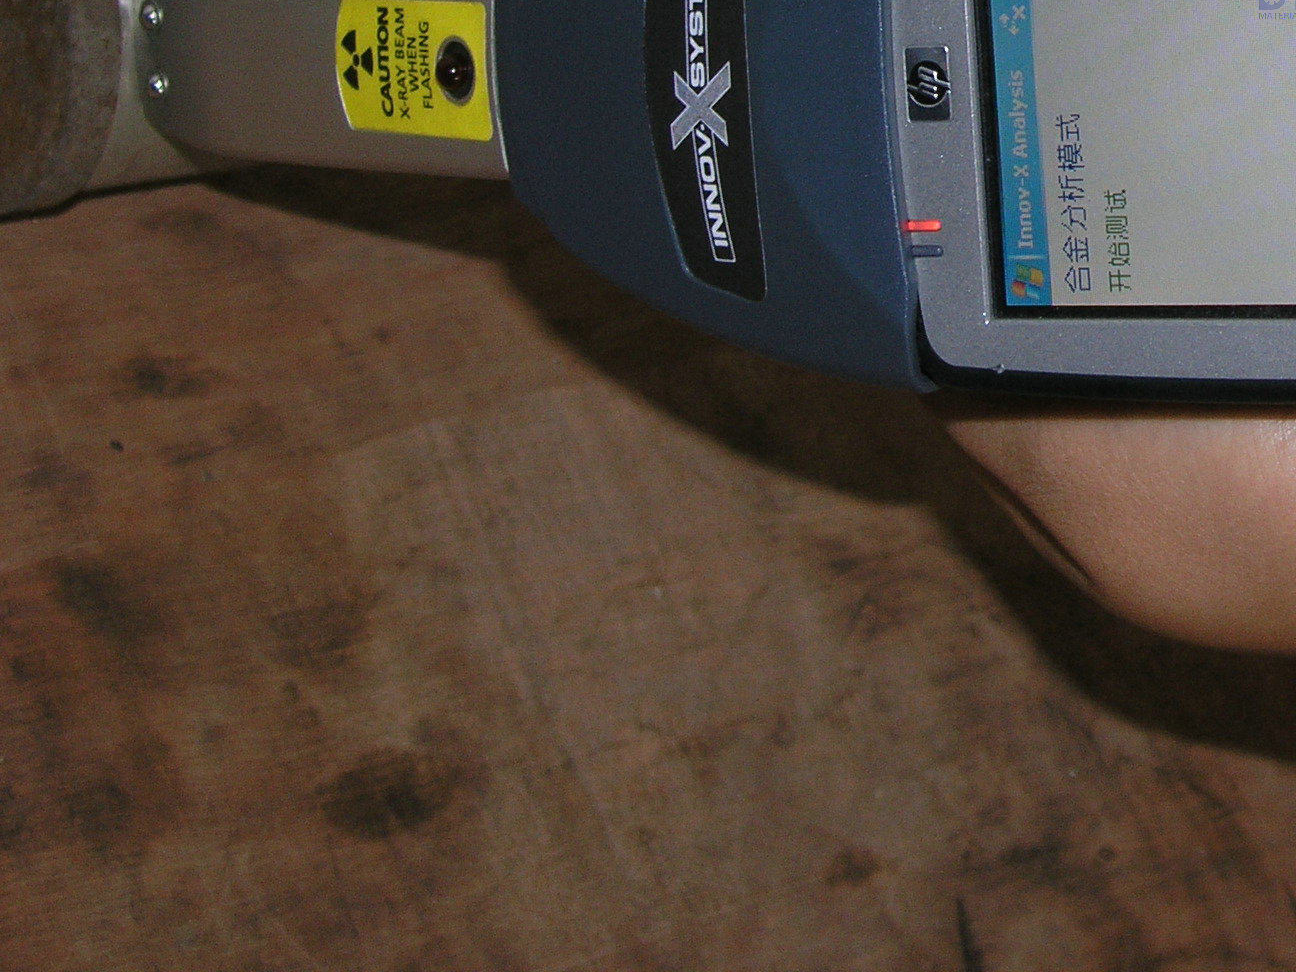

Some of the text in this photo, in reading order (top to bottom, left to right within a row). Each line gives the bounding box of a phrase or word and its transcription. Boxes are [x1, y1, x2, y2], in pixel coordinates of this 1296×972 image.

[377, 6, 394, 117] CAUTION
[394, 7, 411, 119] X-RAY BEAM
[407, 37, 420, 93] WHEN
[419, 21, 434, 110] FLASHING
[1008, 70, 1034, 249] Innov-X Analysis
[1055, 112, 1092, 293] 合金分析模式
[1104, 189, 1132, 293] 开始测试
